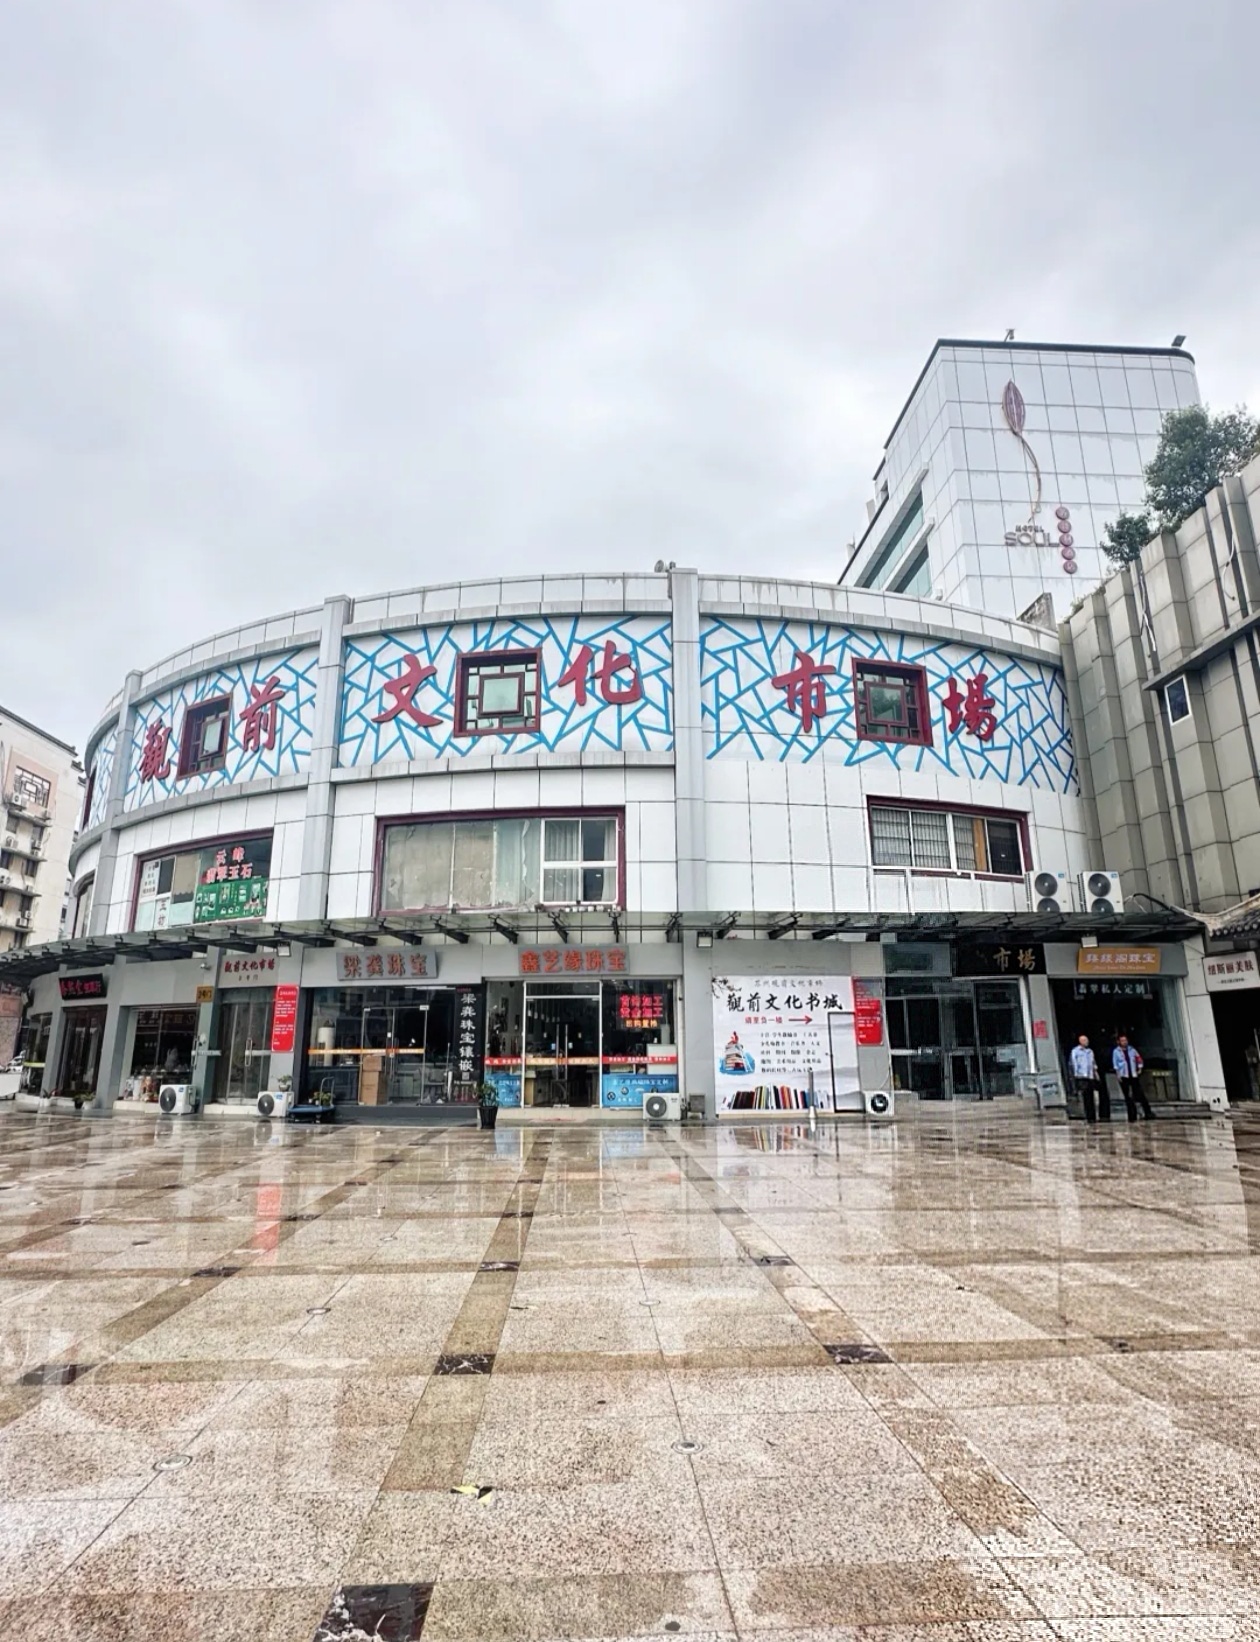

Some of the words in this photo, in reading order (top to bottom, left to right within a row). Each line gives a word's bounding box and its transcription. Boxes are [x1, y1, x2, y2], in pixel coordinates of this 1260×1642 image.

[1004, 532, 1060, 547] SOUL
[520, 949, 627, 974] 鑫艺缘珠宝
